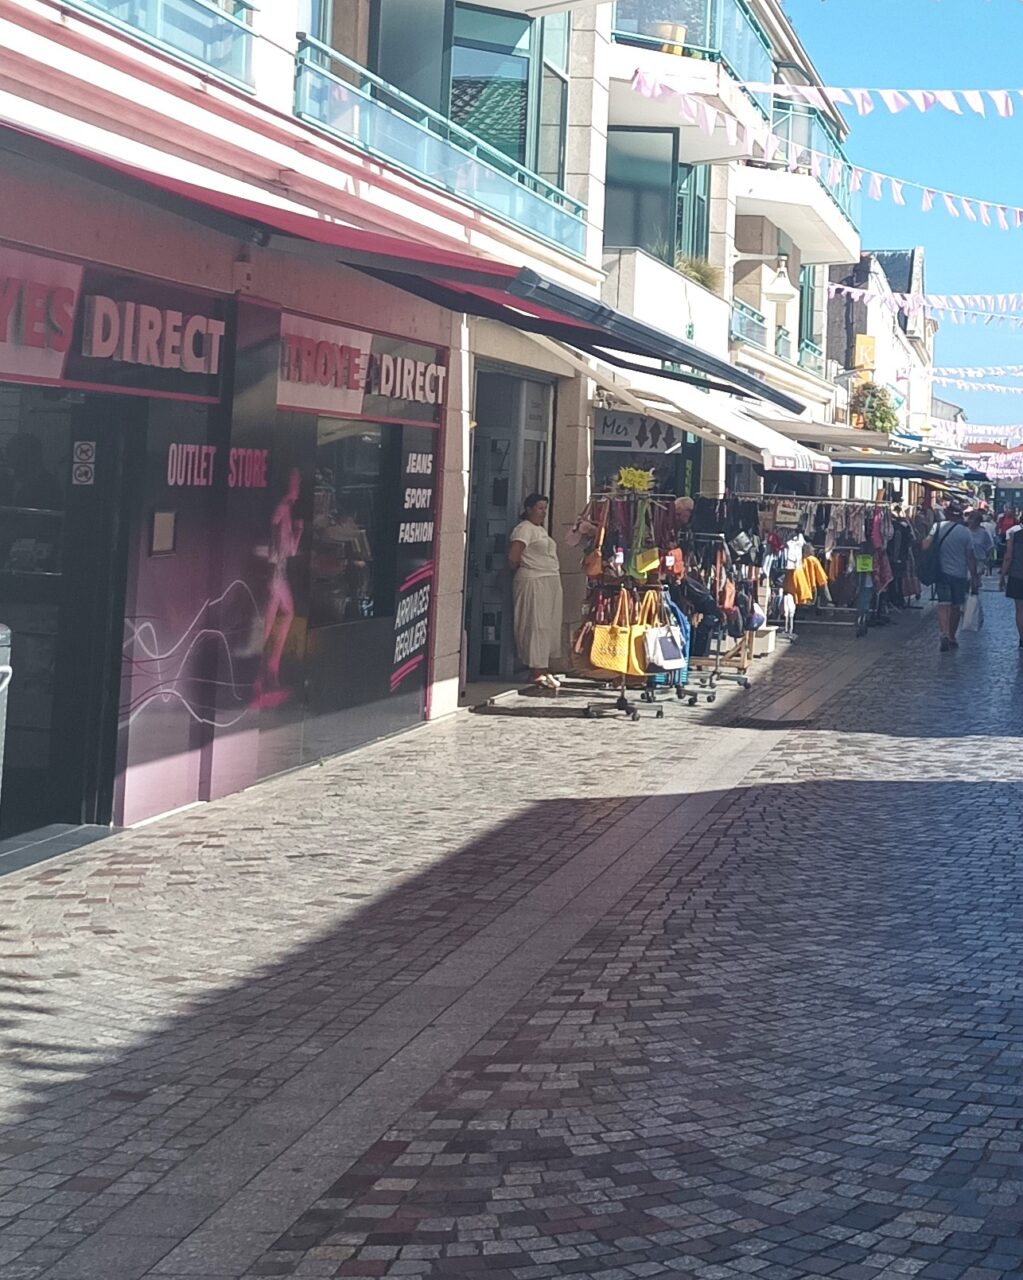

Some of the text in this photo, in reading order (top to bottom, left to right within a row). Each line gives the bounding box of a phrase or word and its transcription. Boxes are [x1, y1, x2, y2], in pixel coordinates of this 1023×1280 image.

[88, 294, 226, 375] DIRECT
[379, 353, 447, 405] DIRECT
[167, 442, 269, 488] OUTLET STORE
[406, 453, 433, 474] JEANS
[404, 488, 432, 509] SPORT
[398, 521, 434, 543] FASHION
[394, 584, 431, 630] ARRIVAGES
